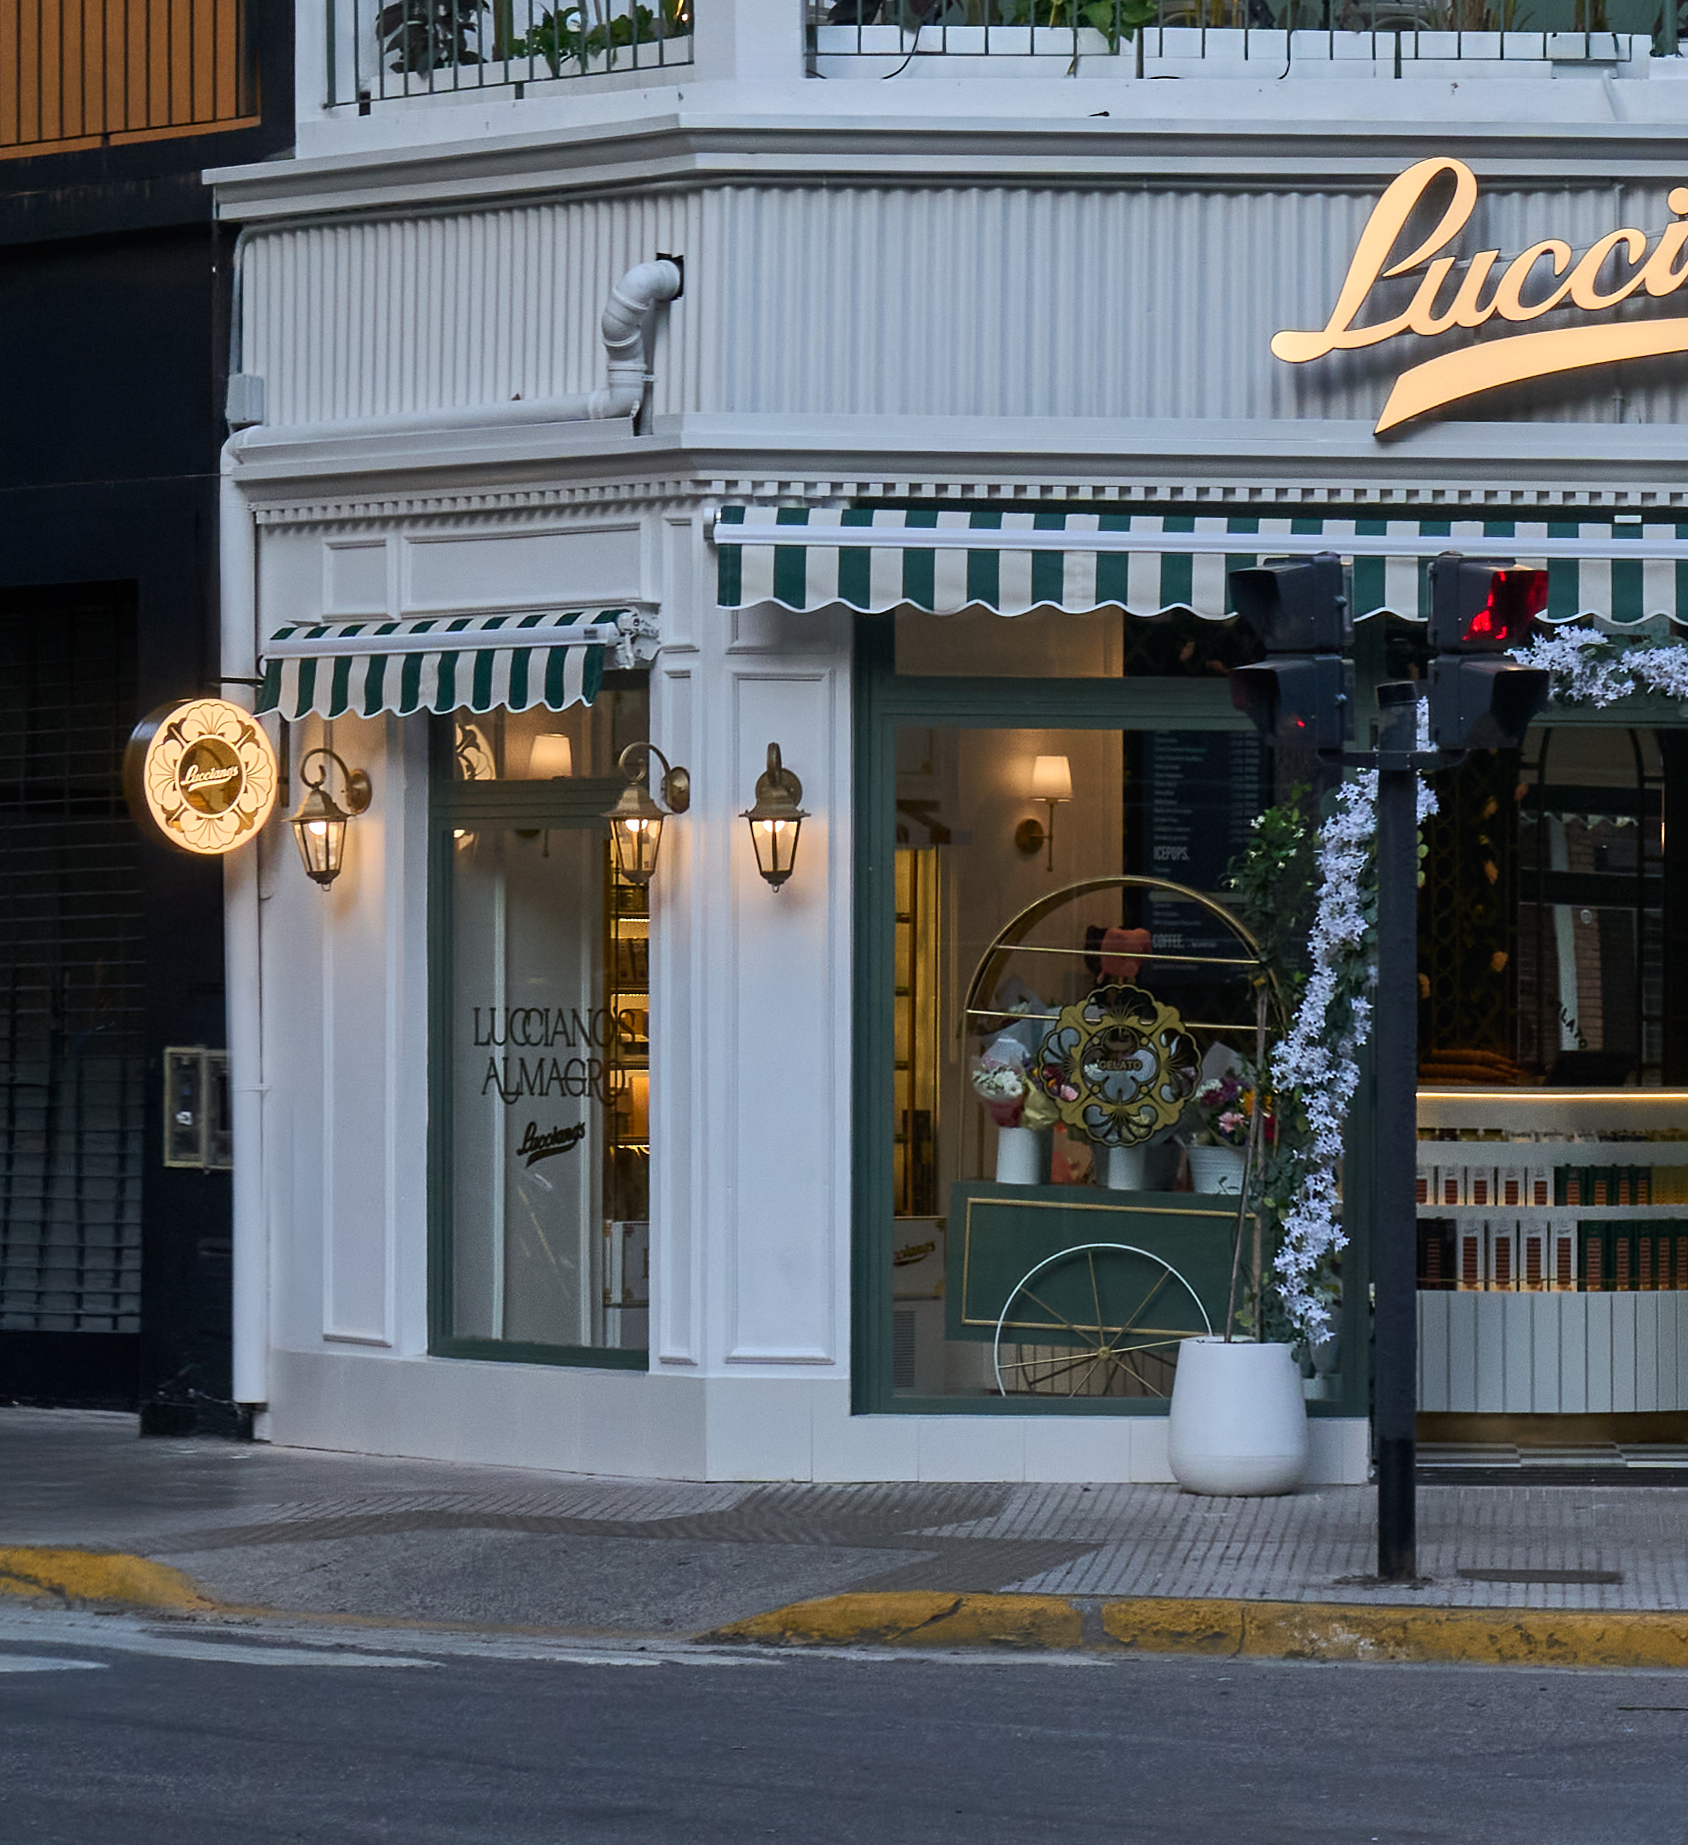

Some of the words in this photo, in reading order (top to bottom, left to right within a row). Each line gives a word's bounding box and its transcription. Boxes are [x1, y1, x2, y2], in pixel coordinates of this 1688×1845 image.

[473, 1005, 636, 1048] LUCCIANO'S
[481, 1057, 626, 1106] ALMAGRO
[1098, 1059, 1143, 1071] GELATO
